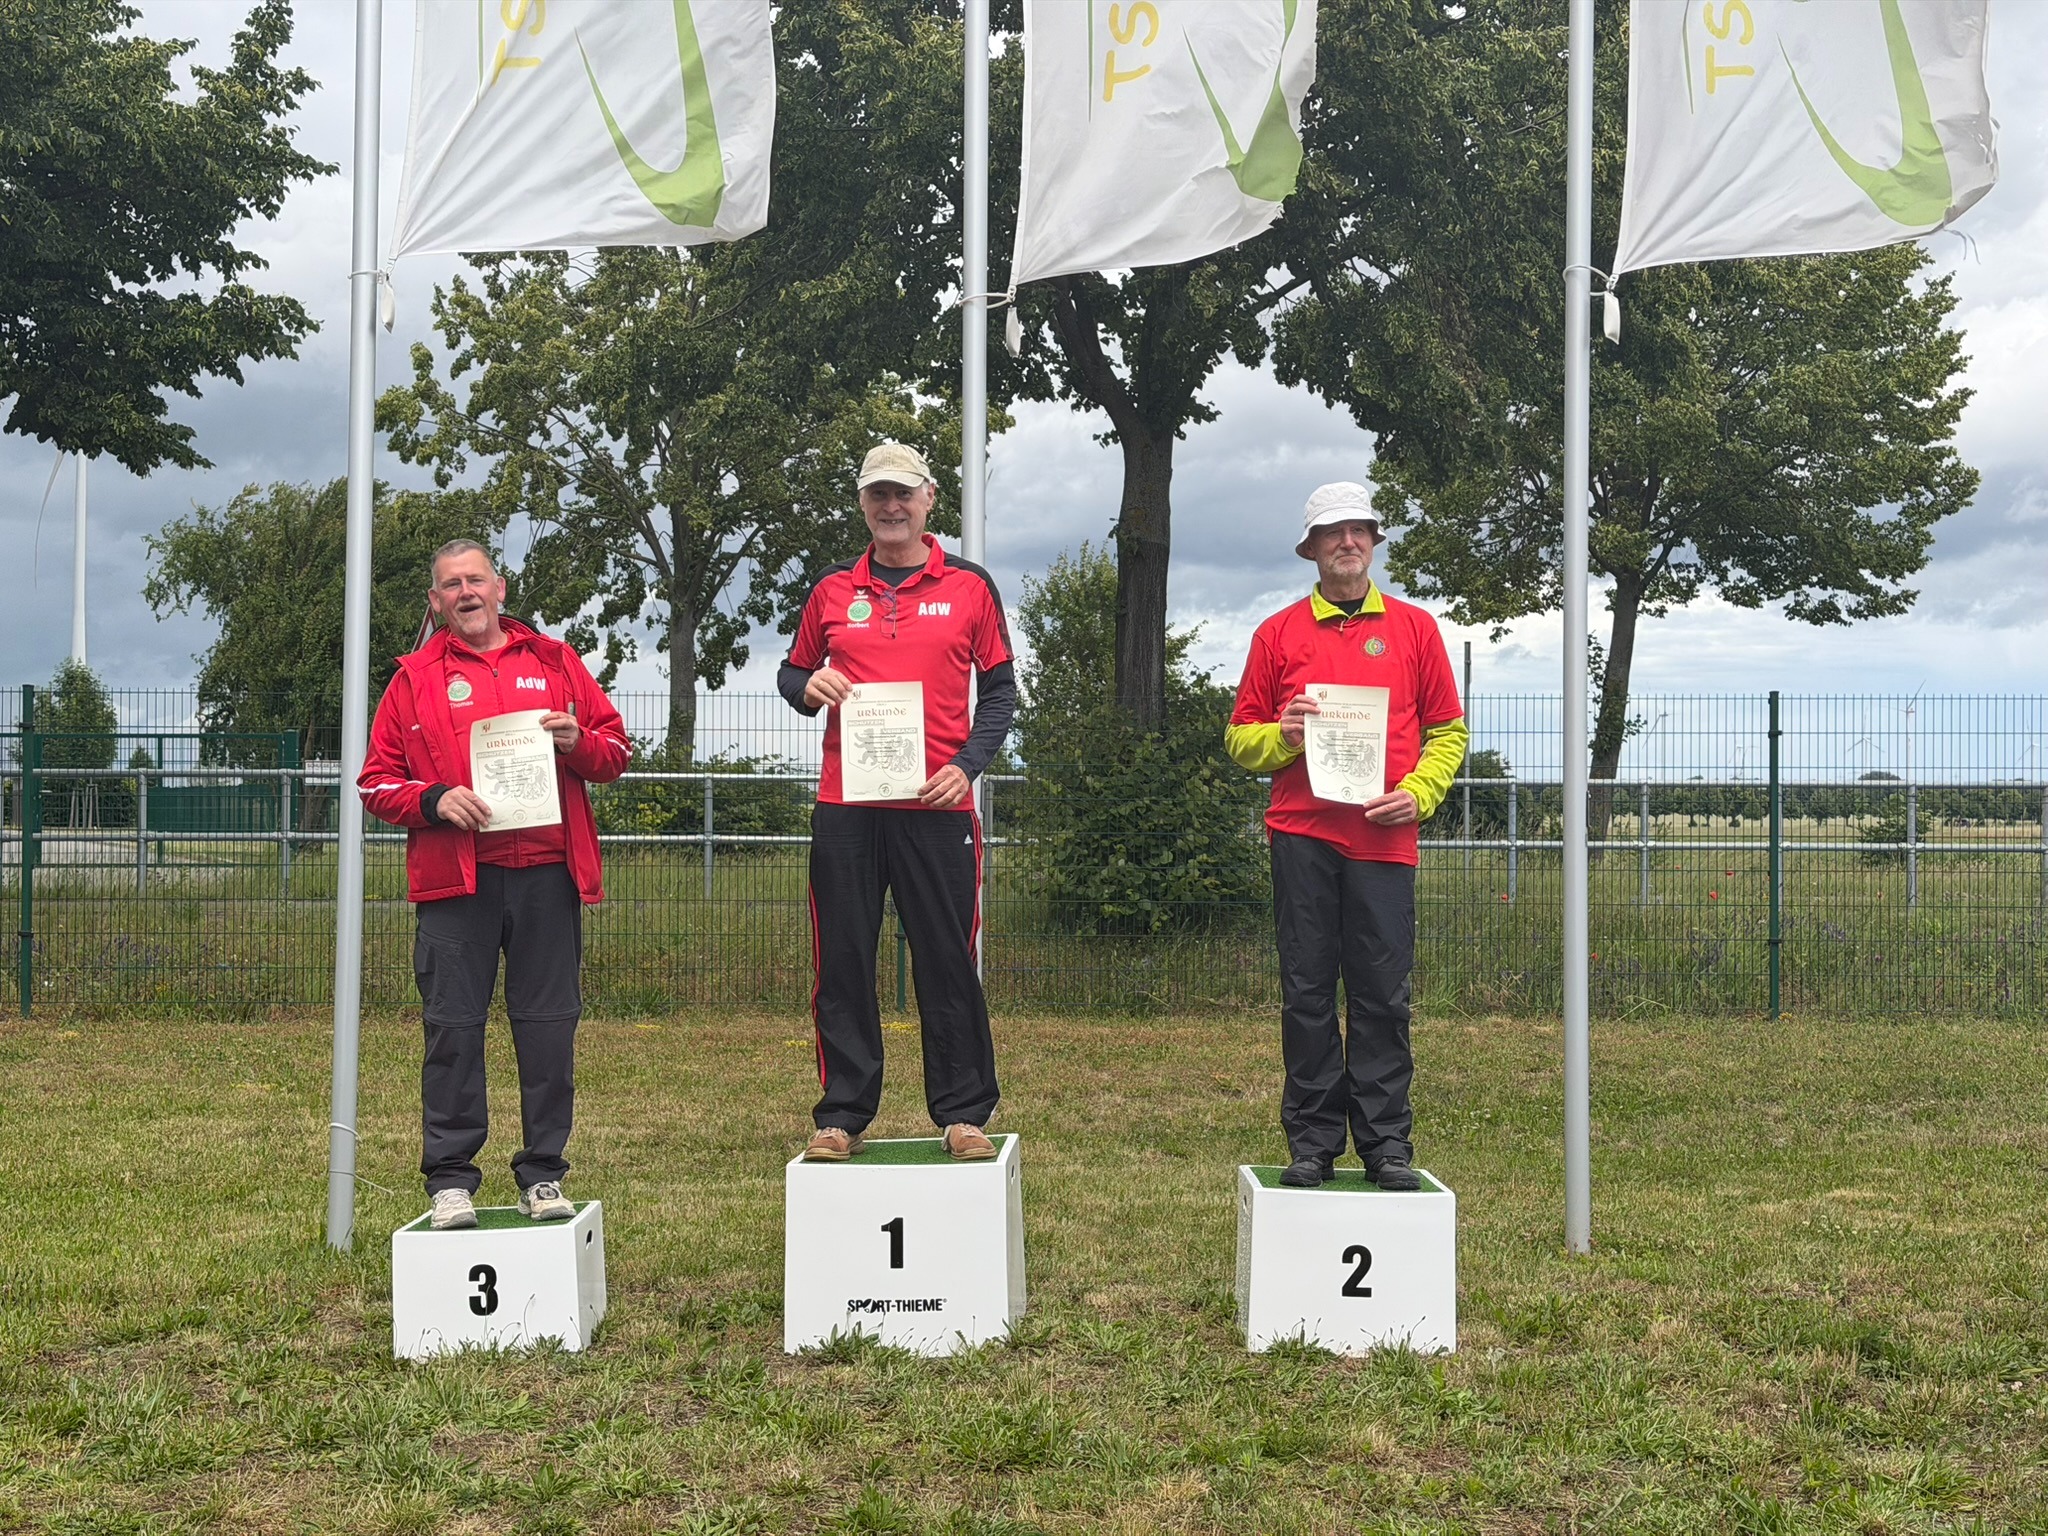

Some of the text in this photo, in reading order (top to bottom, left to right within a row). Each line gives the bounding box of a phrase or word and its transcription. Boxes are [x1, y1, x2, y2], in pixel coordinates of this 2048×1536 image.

[1103, 1, 1159, 102] TS
[1703, 0, 1755, 95] TS
[918, 602, 951, 616] AdW
[449, 701, 474, 709] Thomas
[516, 676, 547, 691] AdW
[881, 1217, 904, 1269] 1
[468, 1264, 499, 1316] 3
[1341, 1244, 1373, 1298] 2
